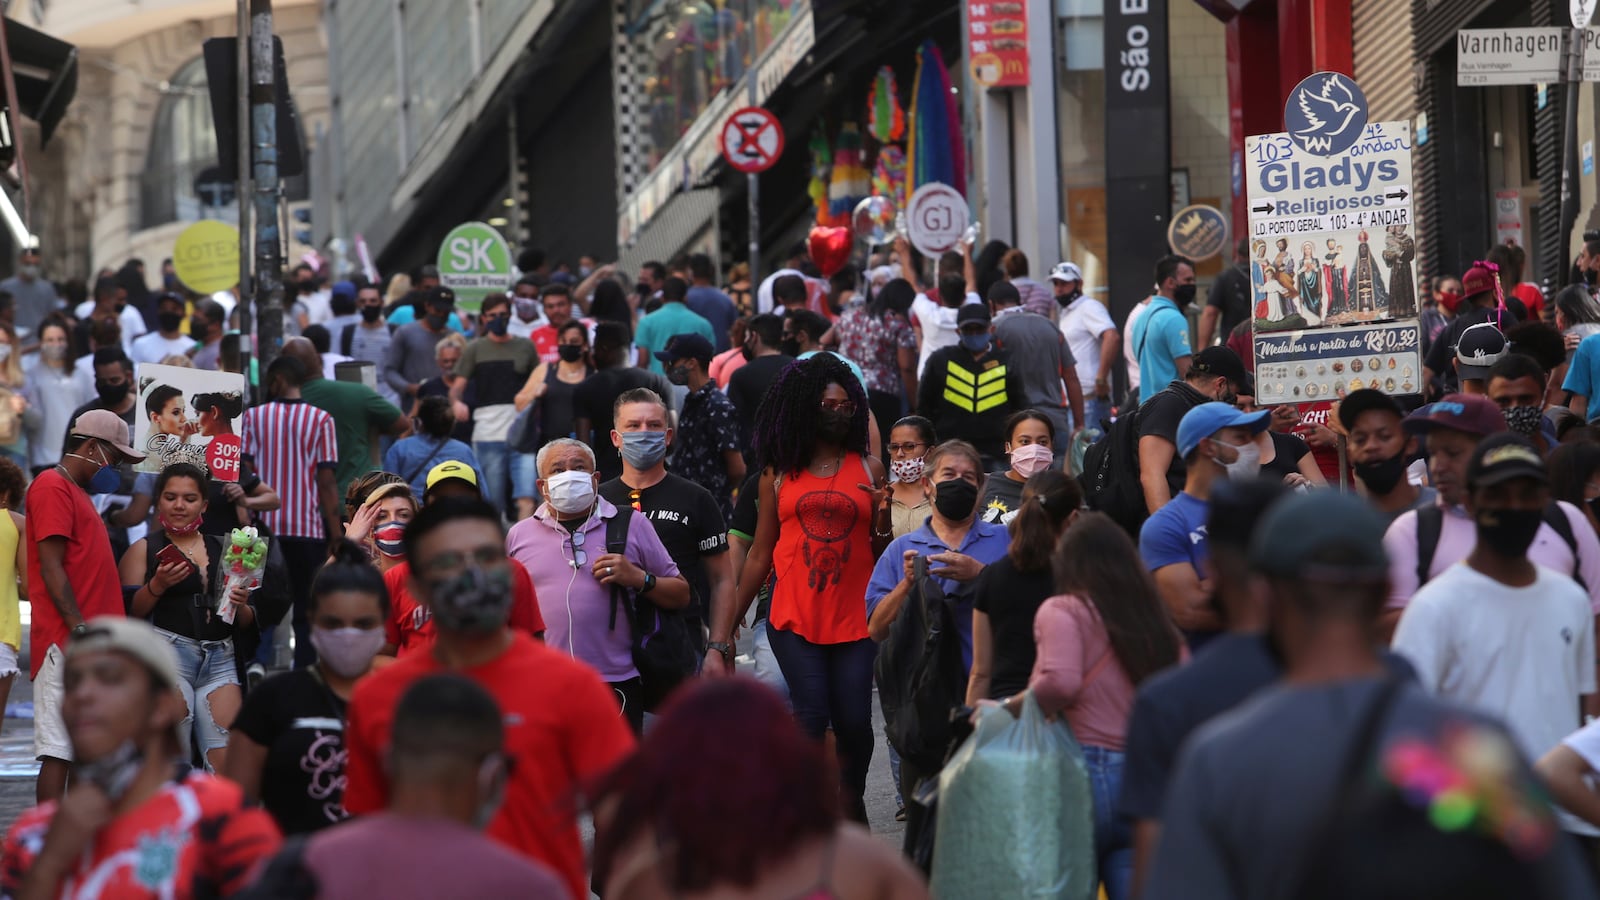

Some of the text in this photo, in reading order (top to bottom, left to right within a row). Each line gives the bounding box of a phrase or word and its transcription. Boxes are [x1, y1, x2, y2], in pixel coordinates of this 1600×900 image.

[1460, 32, 1559, 58] Varnhagen
[1121, 25, 1150, 91] São
[1250, 136, 1294, 163] 103
[1350, 138, 1411, 157] andar
[1259, 155, 1400, 193] Gladys
[1275, 193, 1385, 216] Religiosos
[923, 206, 952, 231] GJ
[1269, 220, 1296, 235] PORTO
[1297, 217, 1324, 232] GERAL
[1330, 214, 1347, 230] 103
[1370, 208, 1408, 227] ANDAR
[450, 237, 497, 271] SK
[443, 275, 478, 286] Tecidos
[1255, 337, 1308, 359] Medalhas
[1318, 337, 1350, 355] partir
[1349, 335, 1363, 349] de
[214, 442, 240, 458] 30%
[213, 457, 240, 472] OFF
[657, 510, 679, 521] WAS
[698, 535, 718, 551] OOD
